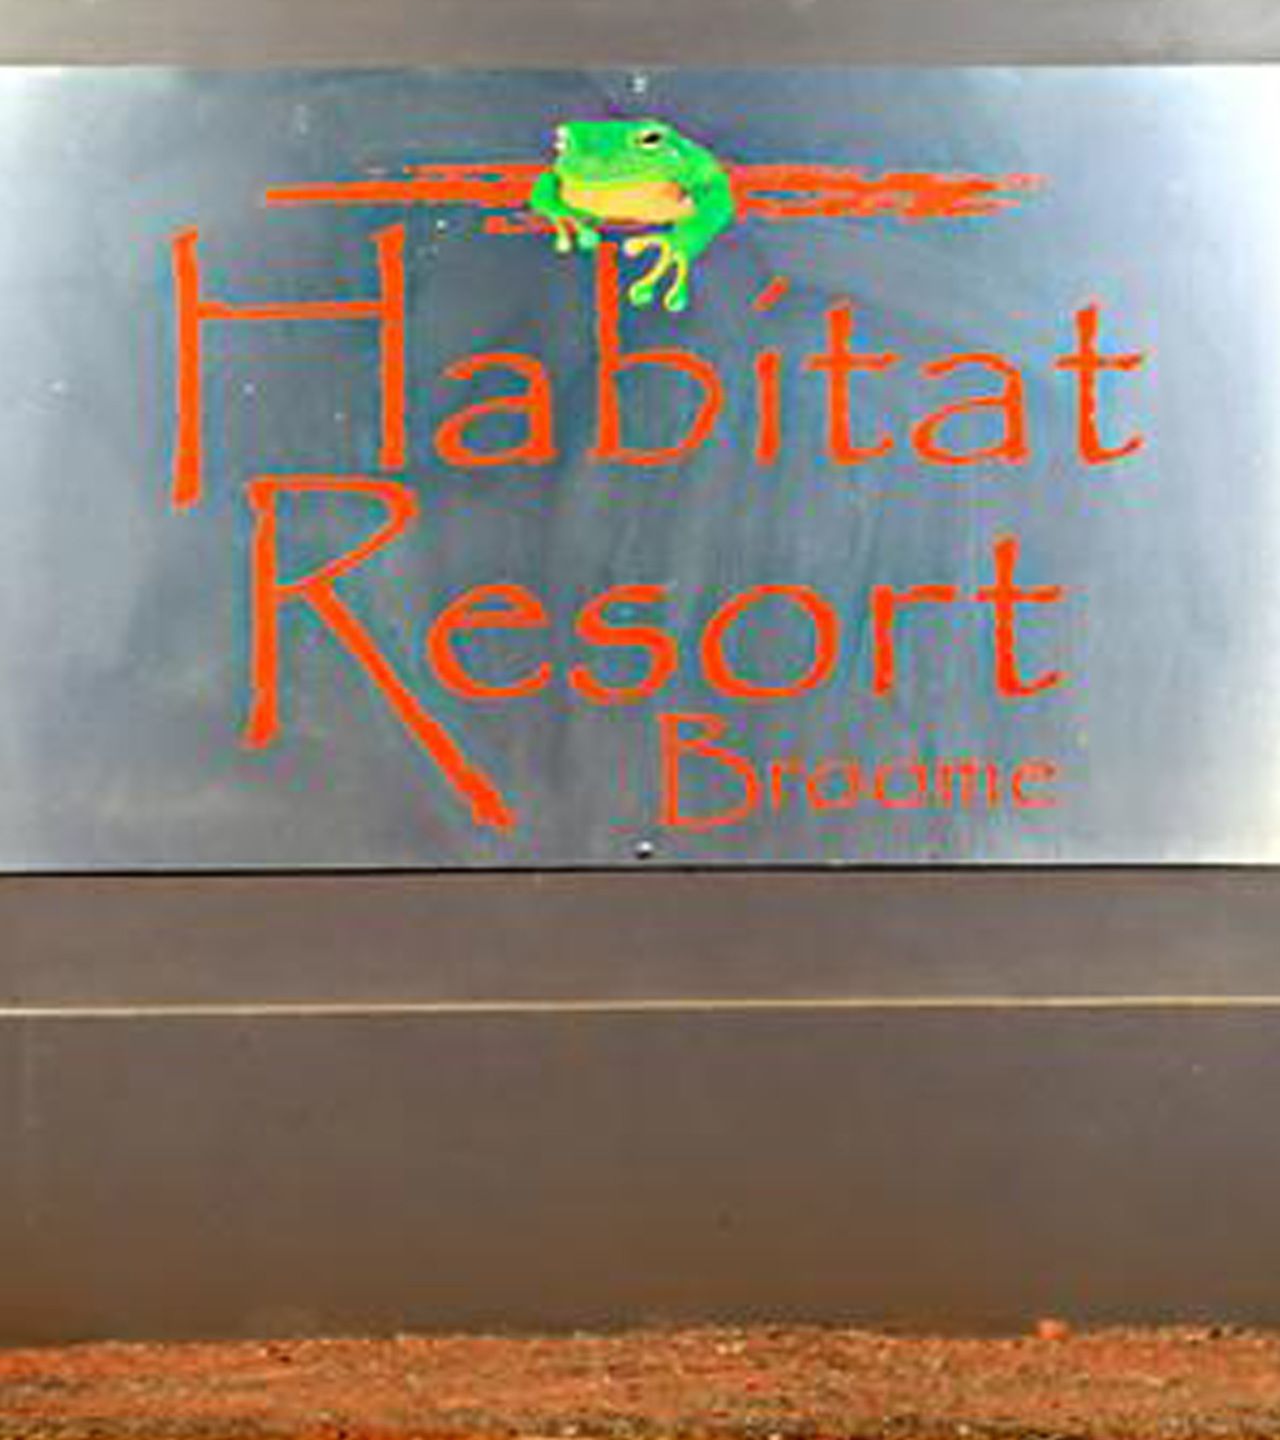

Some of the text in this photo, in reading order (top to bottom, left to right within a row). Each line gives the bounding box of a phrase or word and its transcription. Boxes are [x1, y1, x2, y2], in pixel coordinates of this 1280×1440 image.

[170, 223, 1144, 509] Habitat
[243, 474, 1068, 834] Resort
[656, 712, 1060, 834] Broome
